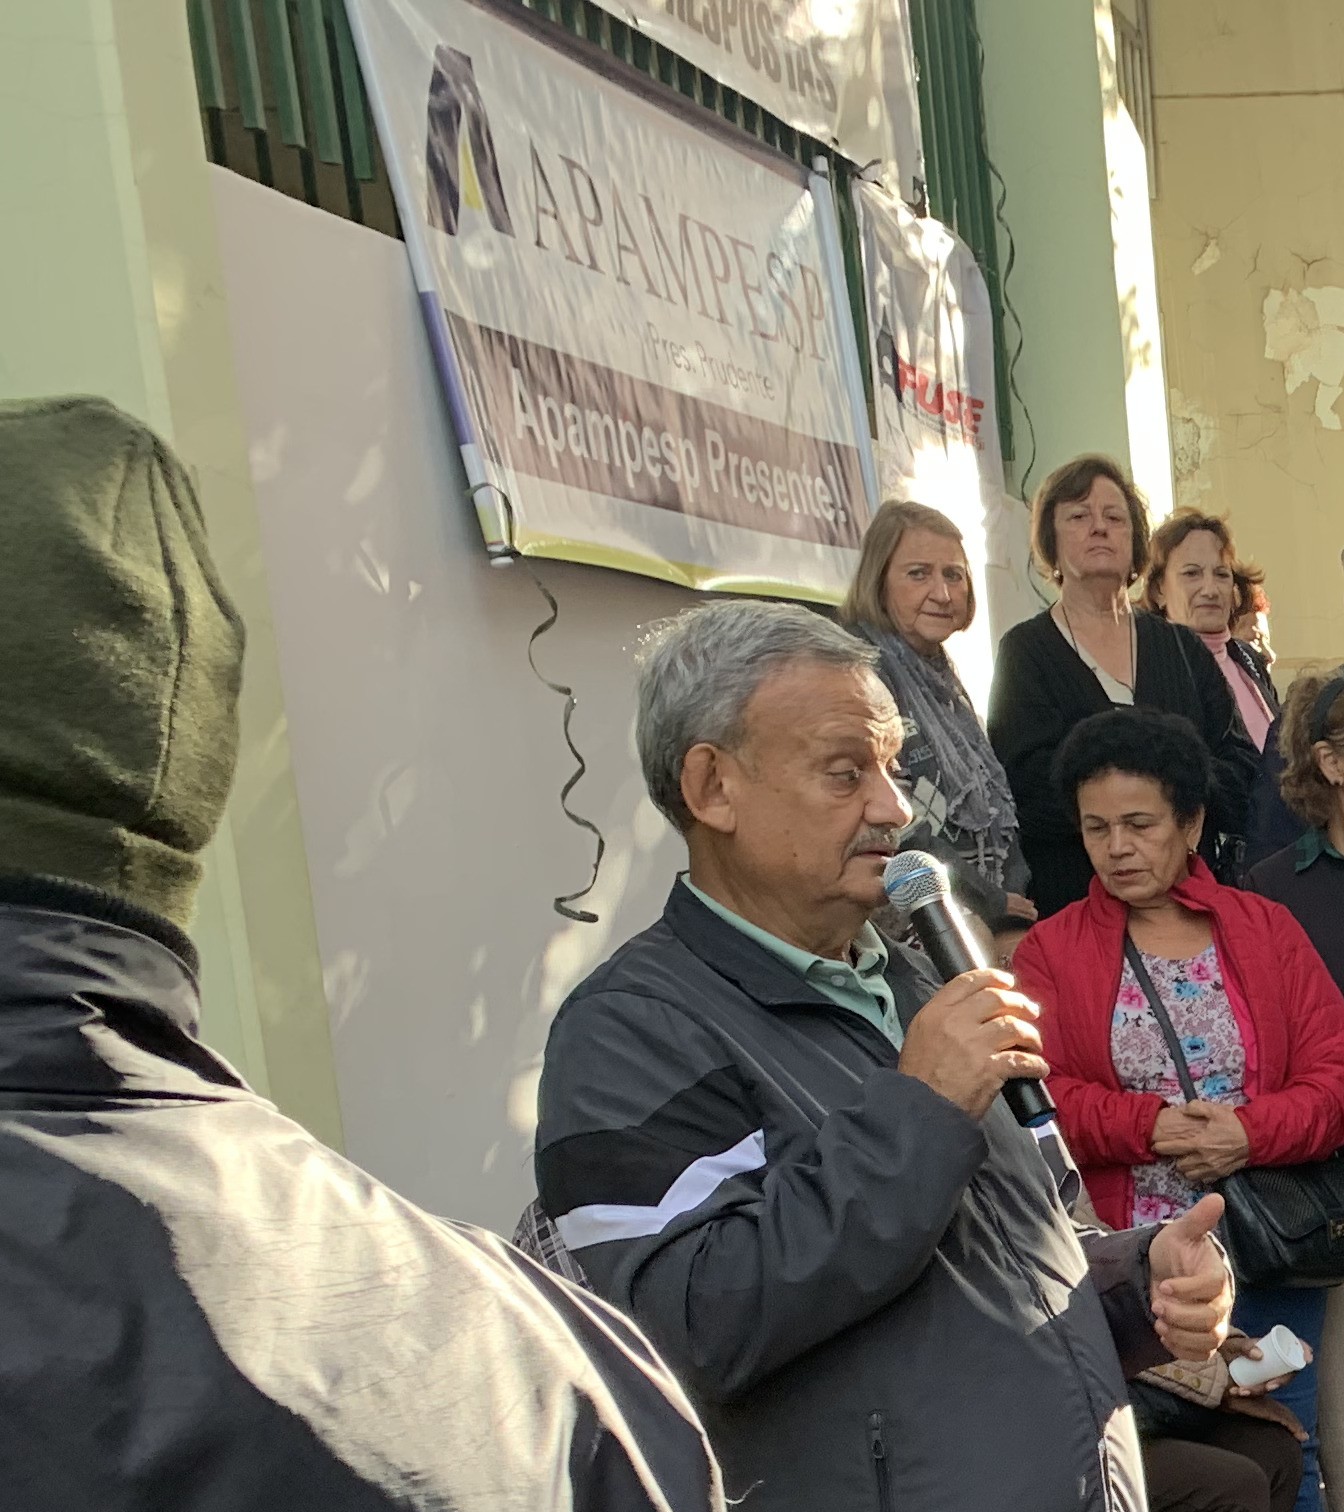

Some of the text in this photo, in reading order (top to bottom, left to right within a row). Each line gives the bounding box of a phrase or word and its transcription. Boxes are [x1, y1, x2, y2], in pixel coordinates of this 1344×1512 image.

[529, 137, 826, 361] APAMPESP
[647, 321, 775, 401] Pres. Prudente
[511, 366, 700, 502] Apampesp
